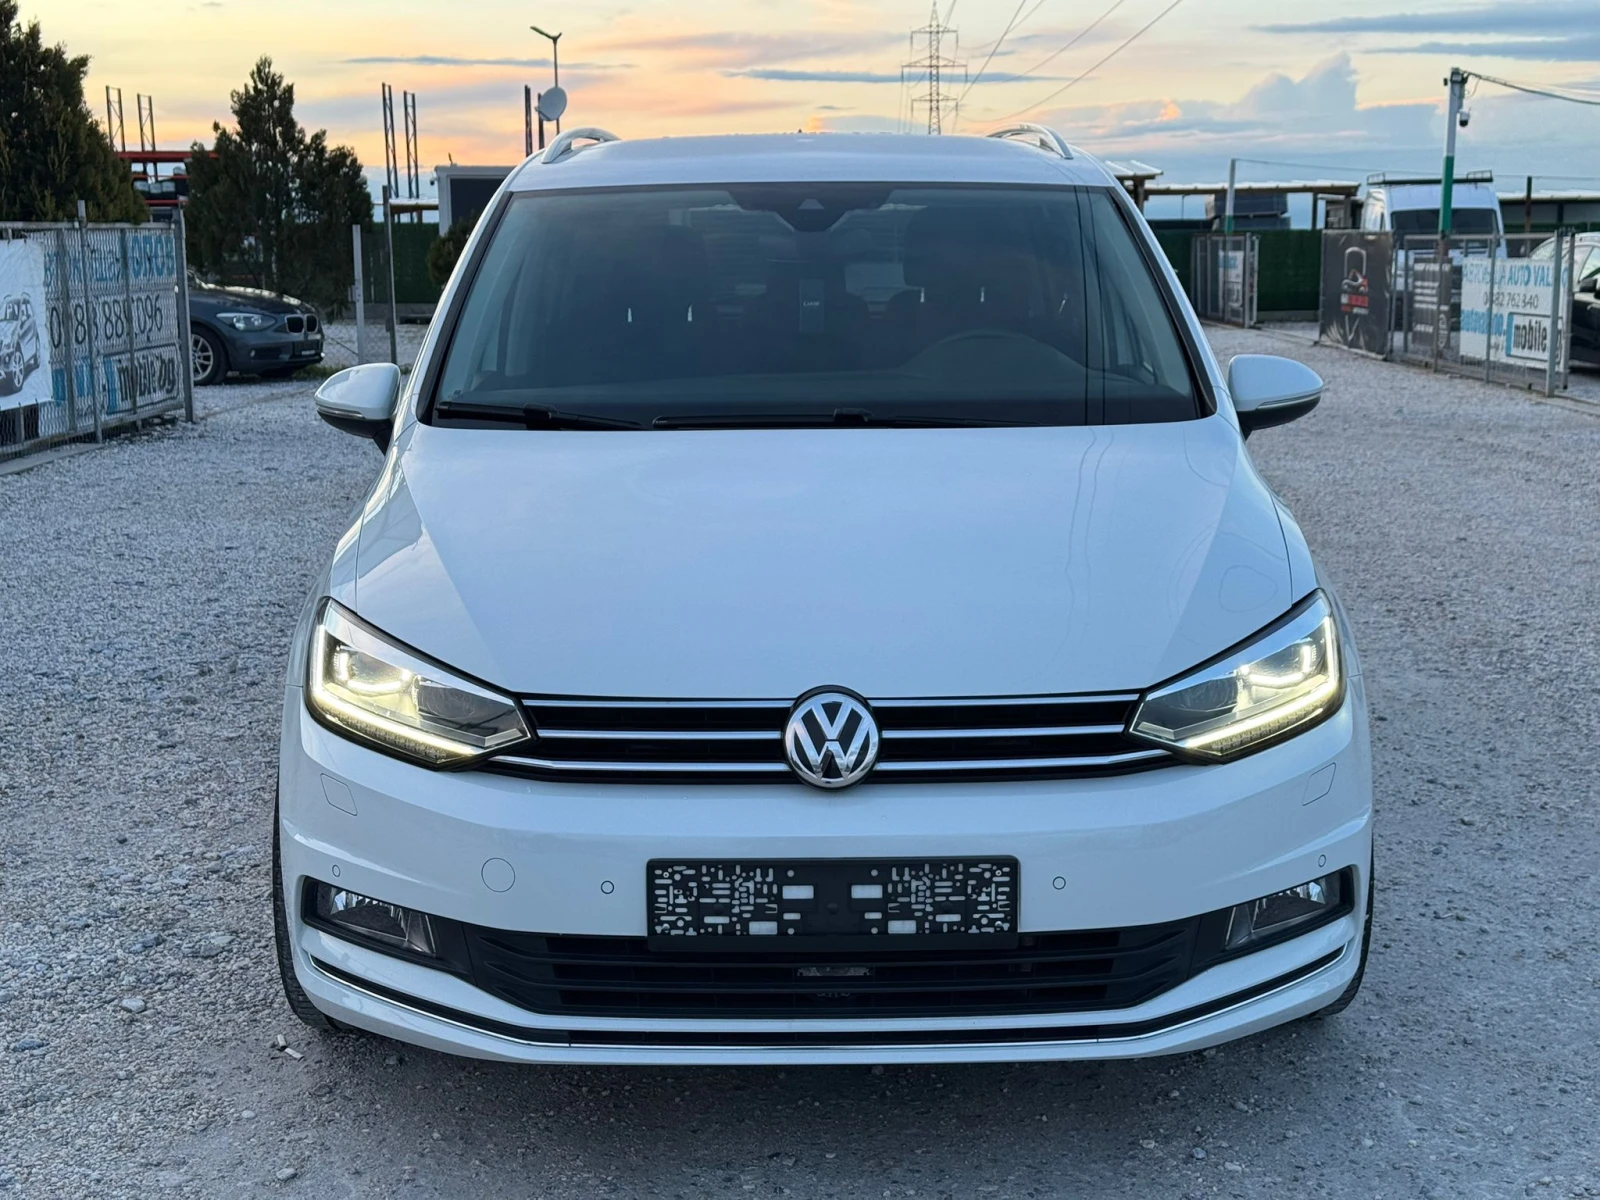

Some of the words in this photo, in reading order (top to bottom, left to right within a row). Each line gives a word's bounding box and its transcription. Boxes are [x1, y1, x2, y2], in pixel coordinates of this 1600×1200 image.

[1507, 264, 1532, 286] AUTO
[1533, 264, 1568, 289] VALO
[1484, 291, 1504, 307] 082
[1507, 291, 1520, 308] 762
